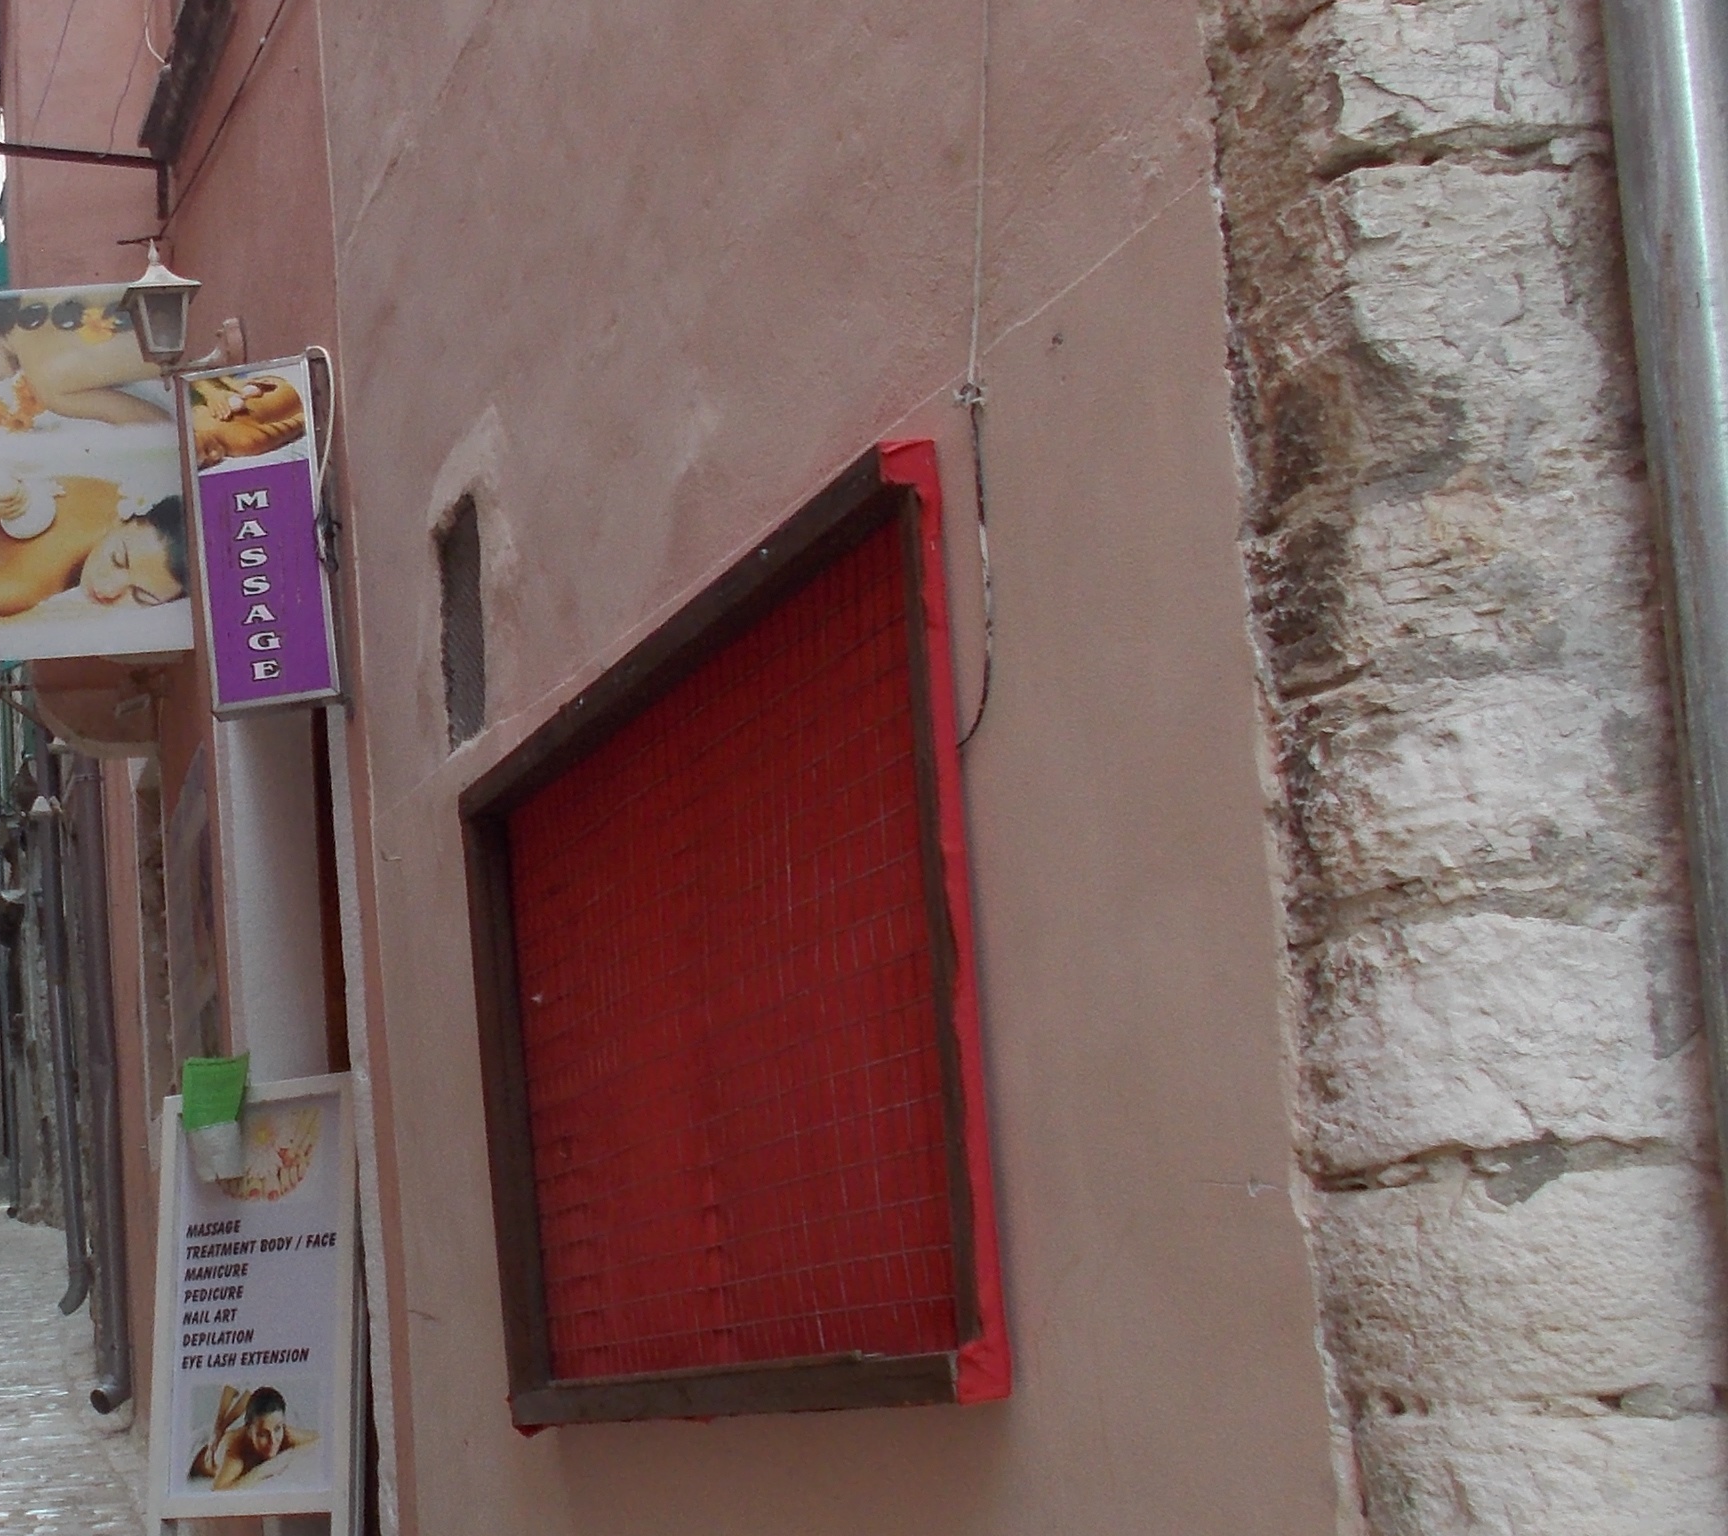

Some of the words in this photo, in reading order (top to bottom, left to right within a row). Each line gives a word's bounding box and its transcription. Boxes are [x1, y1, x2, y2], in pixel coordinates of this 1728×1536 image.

[234, 490, 281, 680] MASSAGE
[186, 1220, 241, 1238] MASSAGE
[186, 1240, 256, 1259] TREATMENT
[260, 1236, 293, 1252] BODY
[295, 1235, 302, 1251] /
[306, 1232, 337, 1248] FACE
[184, 1263, 249, 1281] MANICURE
[184, 1285, 244, 1303] PEDICURE
[182, 1311, 210, 1325] NAIL
[214, 1308, 238, 1324] ART
[182, 1329, 254, 1347] DEPILATION
[181, 1355, 203, 1370] EYE
[207, 1352, 236, 1368] LASH
[240, 1347, 310, 1367] EXTENSION
